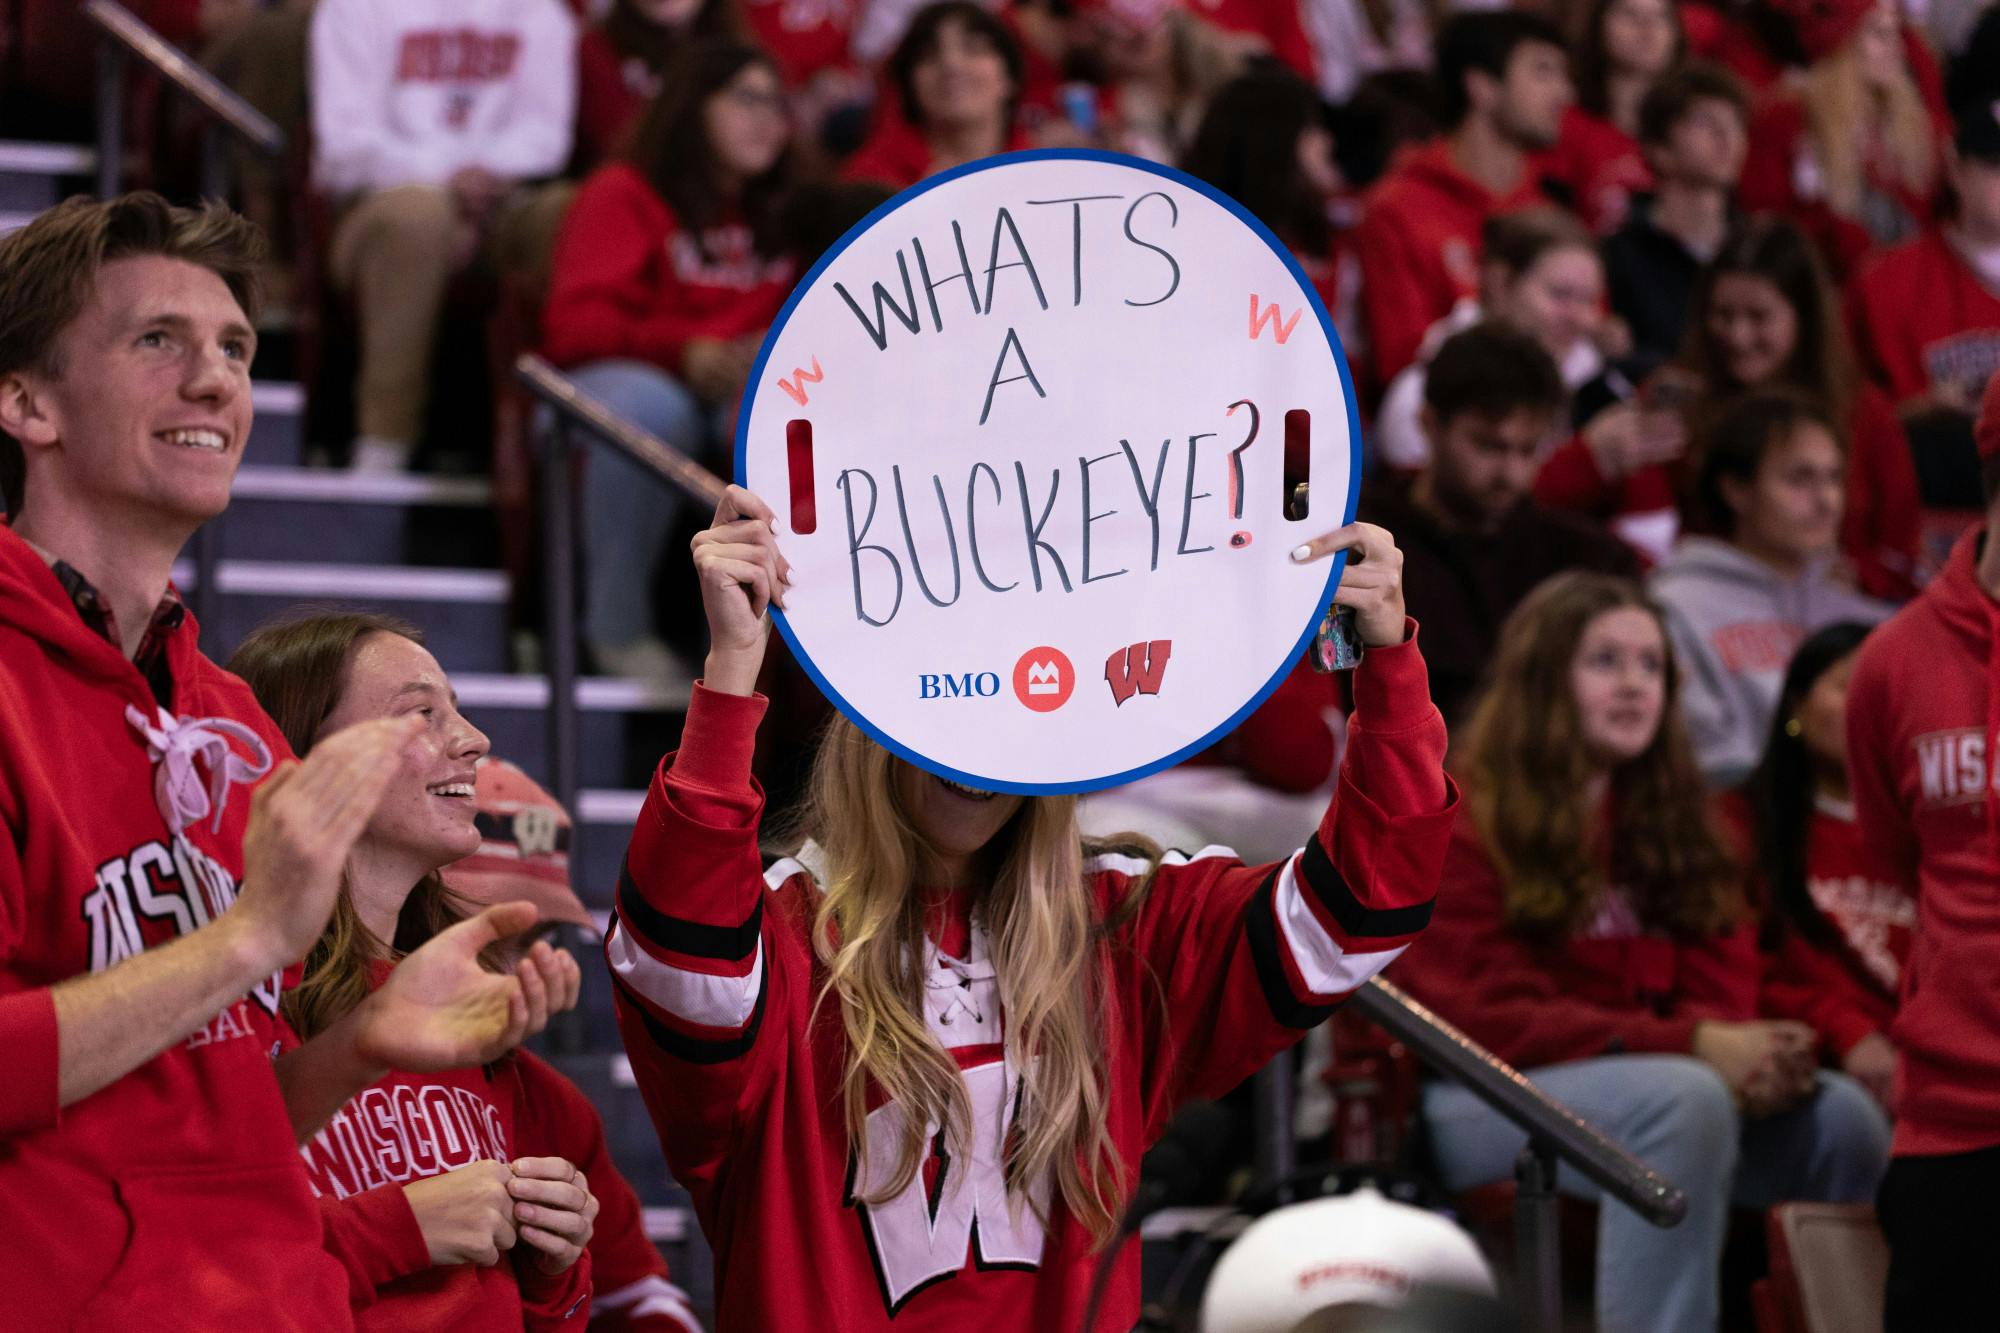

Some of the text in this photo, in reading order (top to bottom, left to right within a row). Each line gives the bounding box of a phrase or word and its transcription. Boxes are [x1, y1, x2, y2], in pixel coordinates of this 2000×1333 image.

[834, 192, 1181, 351] WHATS
[1249, 294, 1302, 345] W
[979, 328, 1046, 426] A
[836, 399, 1260, 627] BUCKEYE?
[919, 672, 1000, 699] BMO
[1104, 639, 1172, 708] W
